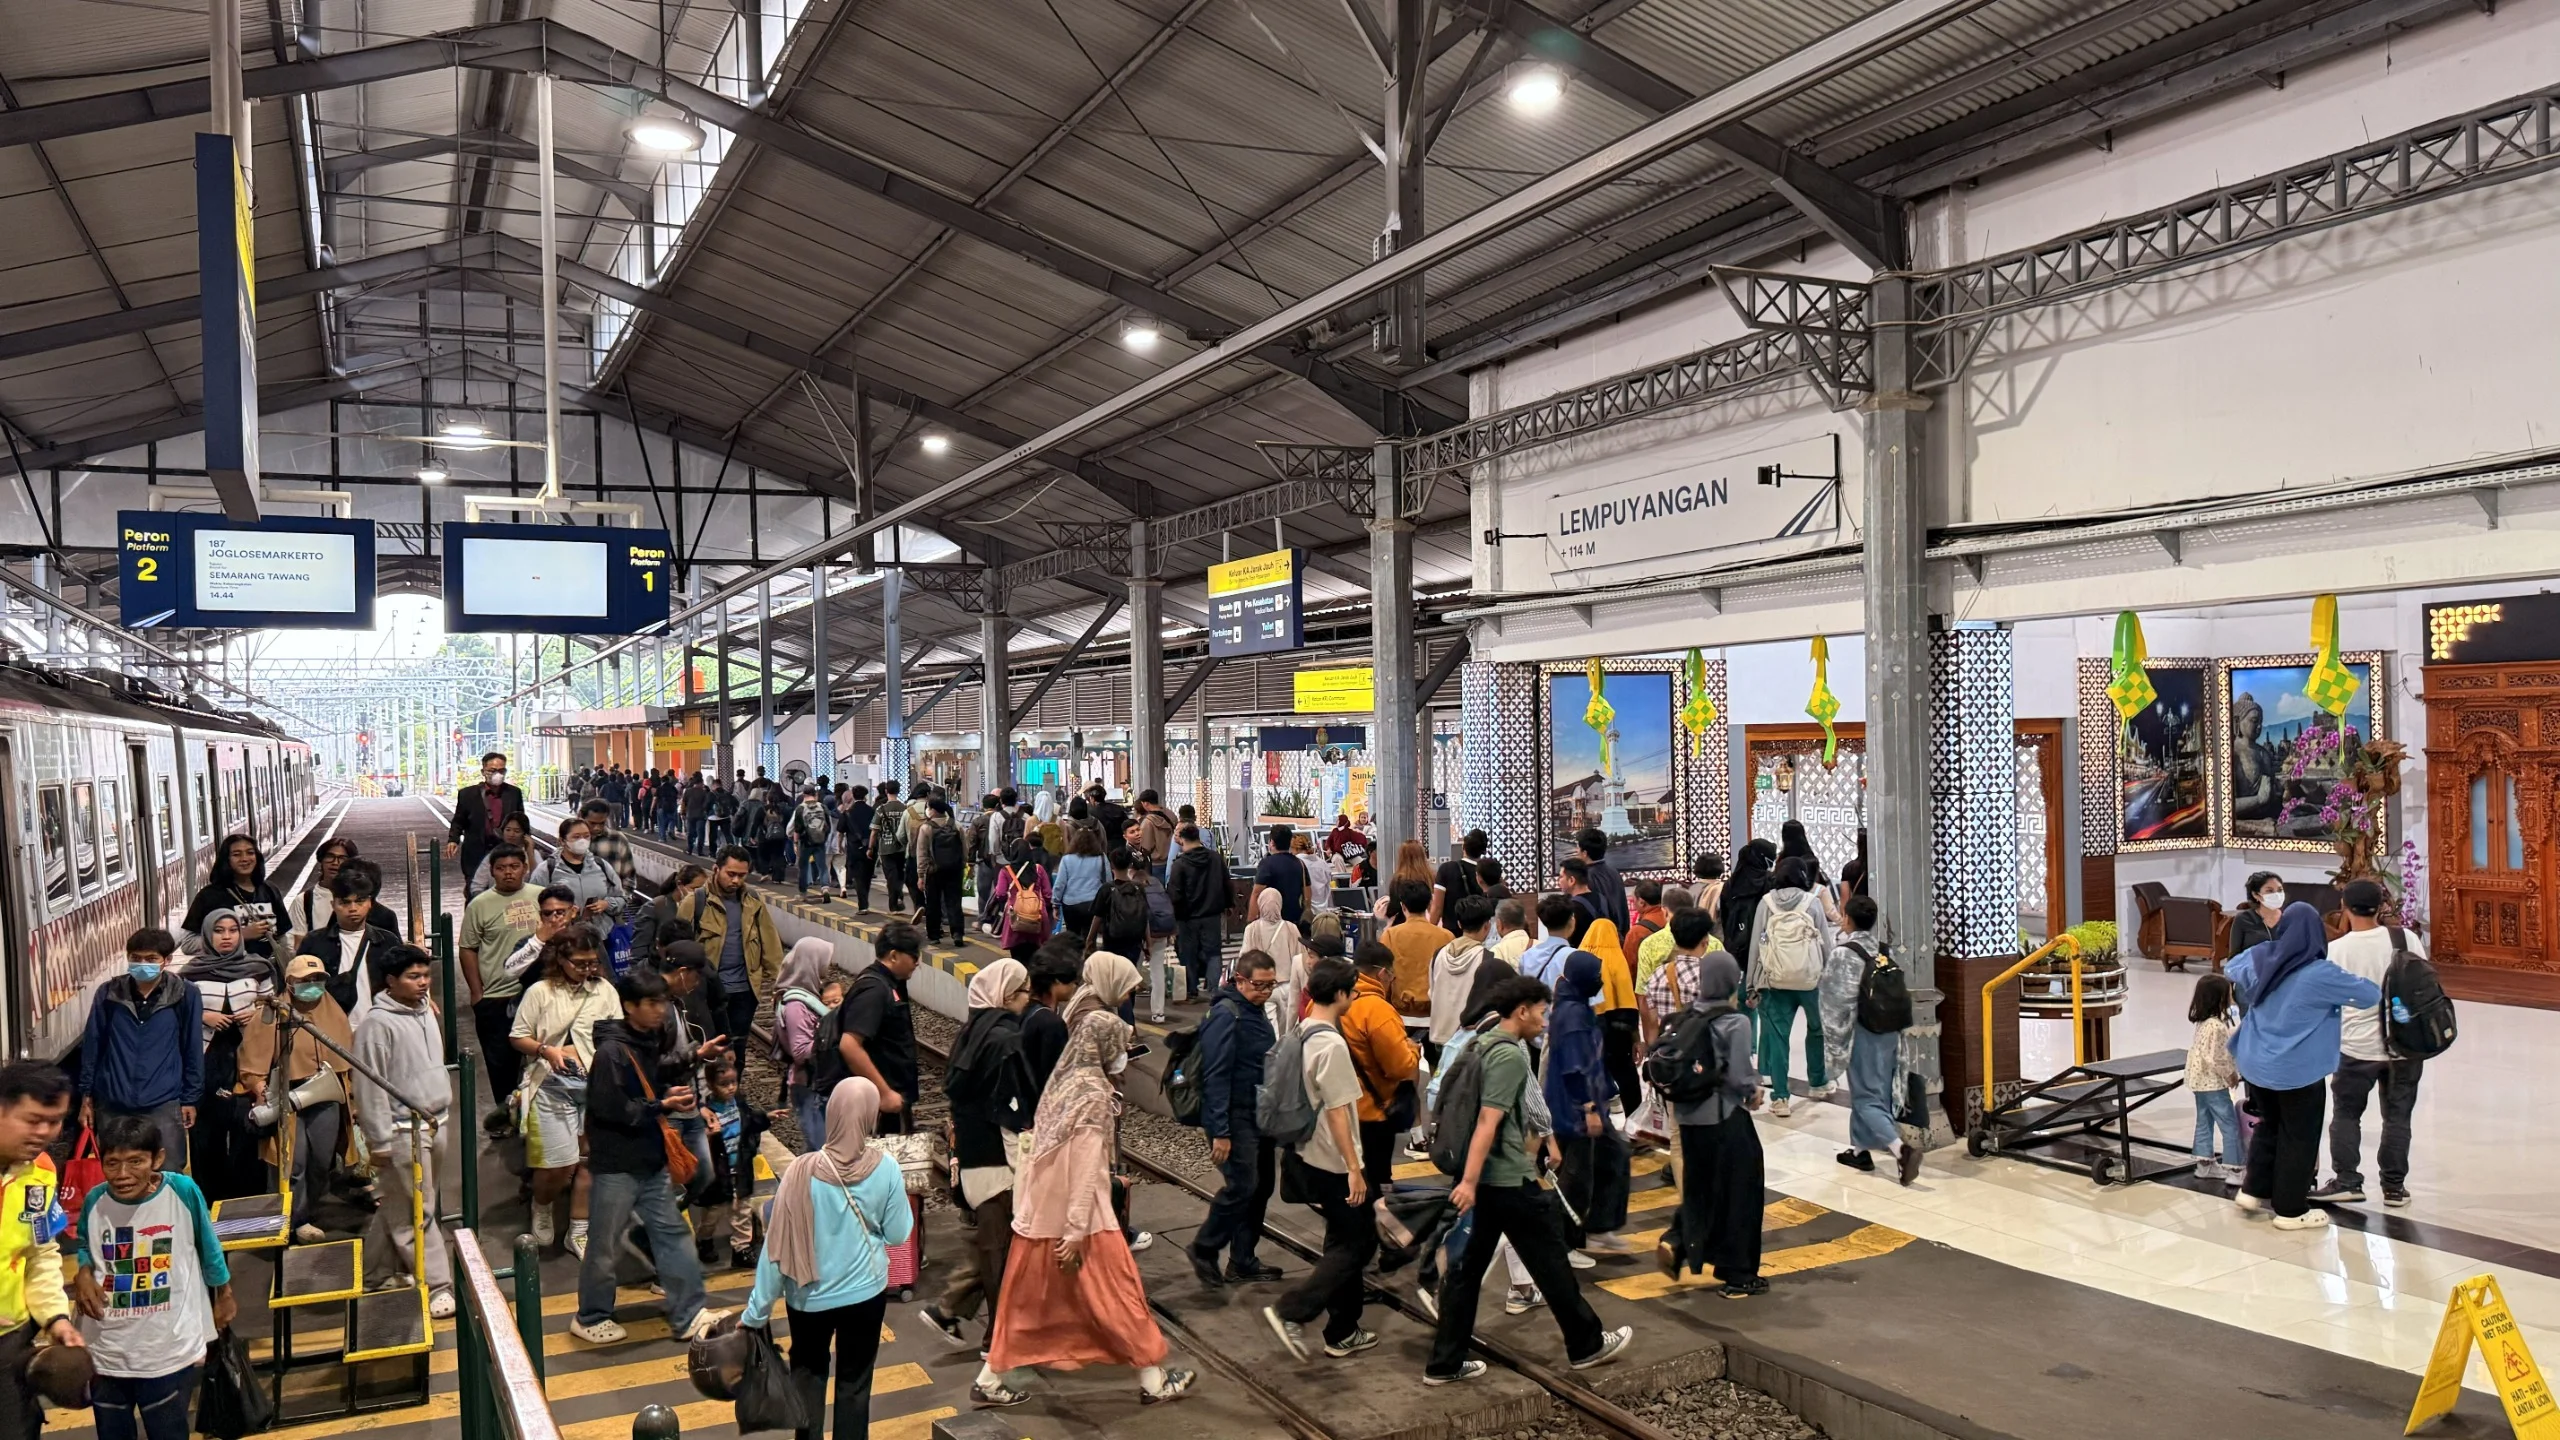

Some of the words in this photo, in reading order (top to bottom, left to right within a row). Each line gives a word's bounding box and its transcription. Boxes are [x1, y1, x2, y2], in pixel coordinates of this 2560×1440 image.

[1560, 477, 1728, 536] LEMPUYANGAN
[124, 528, 170, 542] Peron
[127, 542, 169, 552] Platform
[208, 540, 226, 548] 187
[629, 546, 665, 558] Peron
[1569, 544, 1584, 557] 114
[1586, 541, 1596, 556] M
[209, 549, 324, 561] JOGLOSEMARKERTO
[137, 557, 158, 581] 2
[209, 571, 265, 580] SEMARANG
[267, 572, 310, 581] TAWANG
[642, 571, 653, 592] 1
[136, 1258, 149, 1273] B
[136, 1275, 147, 1289] E
[154, 1271, 168, 1288] A
[1532, 1291, 1542, 1303] N
[2481, 1311, 2507, 1328] CAUTION
[2482, 1328, 2496, 1340] WET
[2496, 1321, 2515, 1336] FLOOR
[2510, 1381, 2543, 1402] HATI-HATI
[2514, 1398, 2536, 1416] LANTAI
[2535, 1392, 2551, 1407] LICIN
